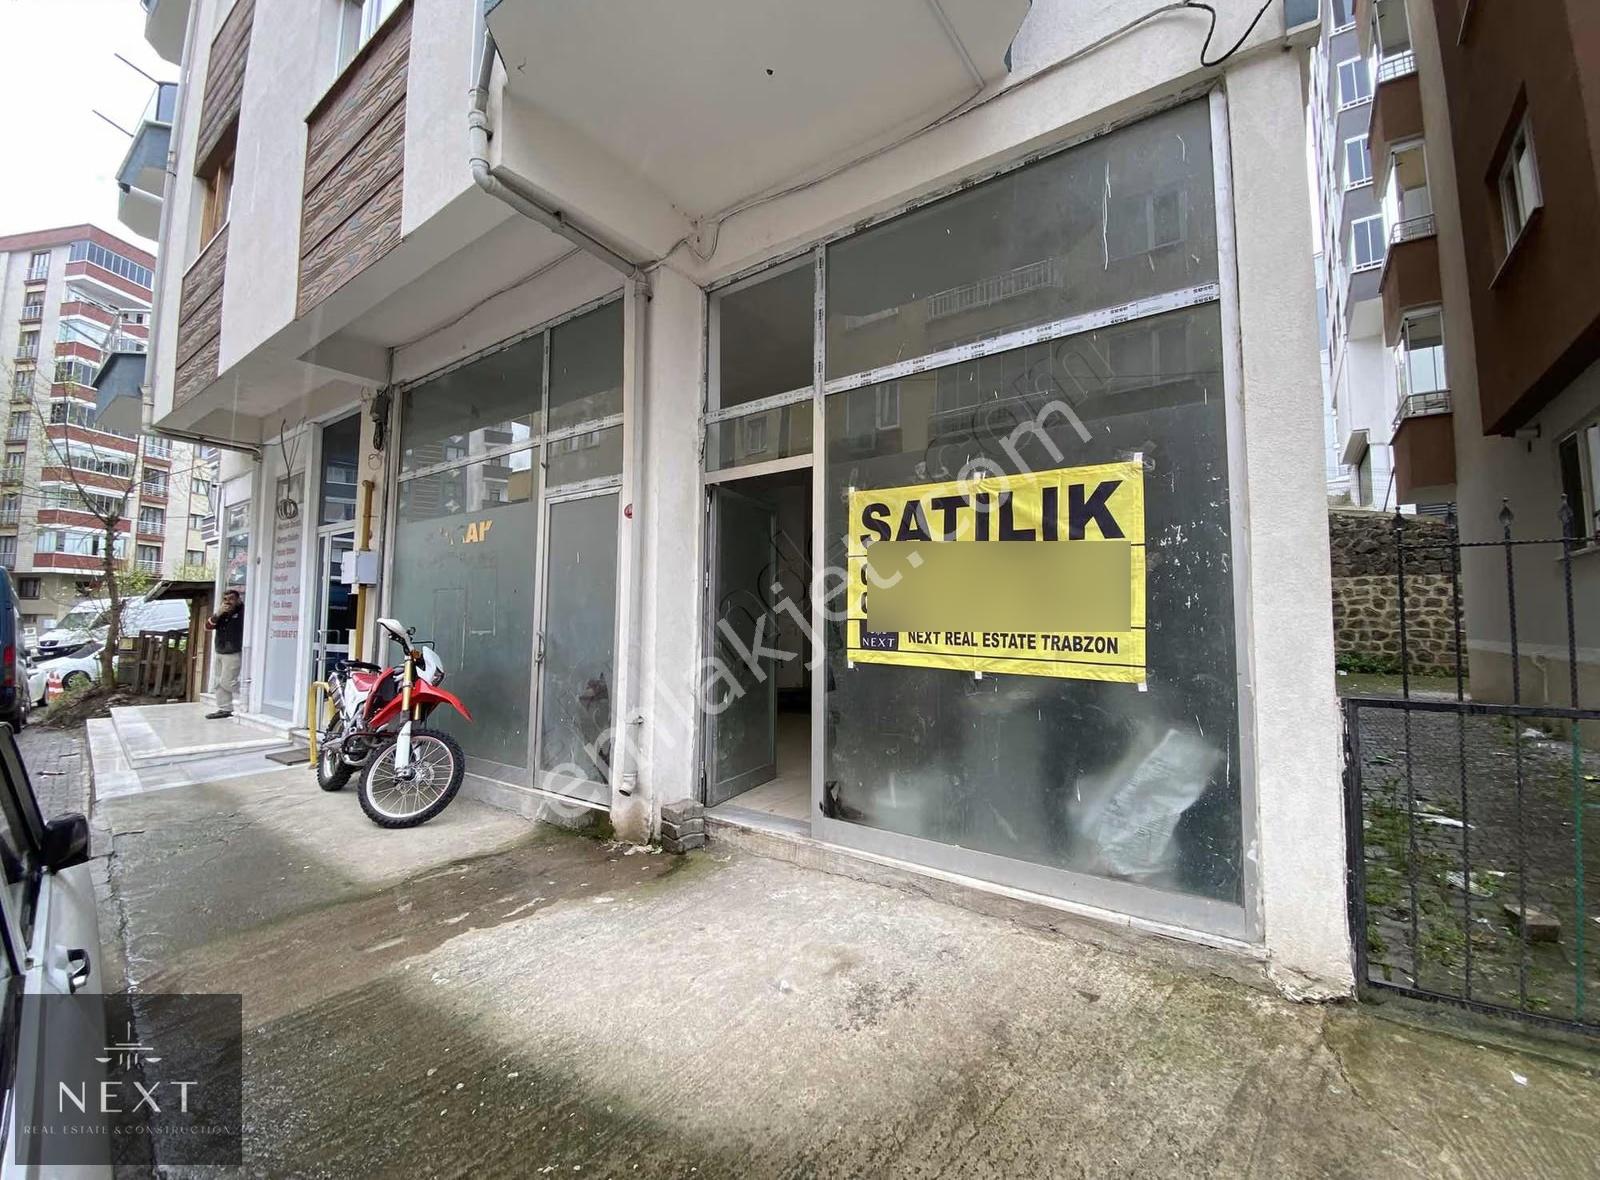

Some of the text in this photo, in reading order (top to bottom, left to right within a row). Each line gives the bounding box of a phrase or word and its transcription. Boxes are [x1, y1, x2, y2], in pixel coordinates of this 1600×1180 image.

[860, 479, 1126, 545] SATILIK
[862, 636, 896, 648] NEXT
[908, 631, 1119, 654] NEXT REAL ESTATE TRABZON
